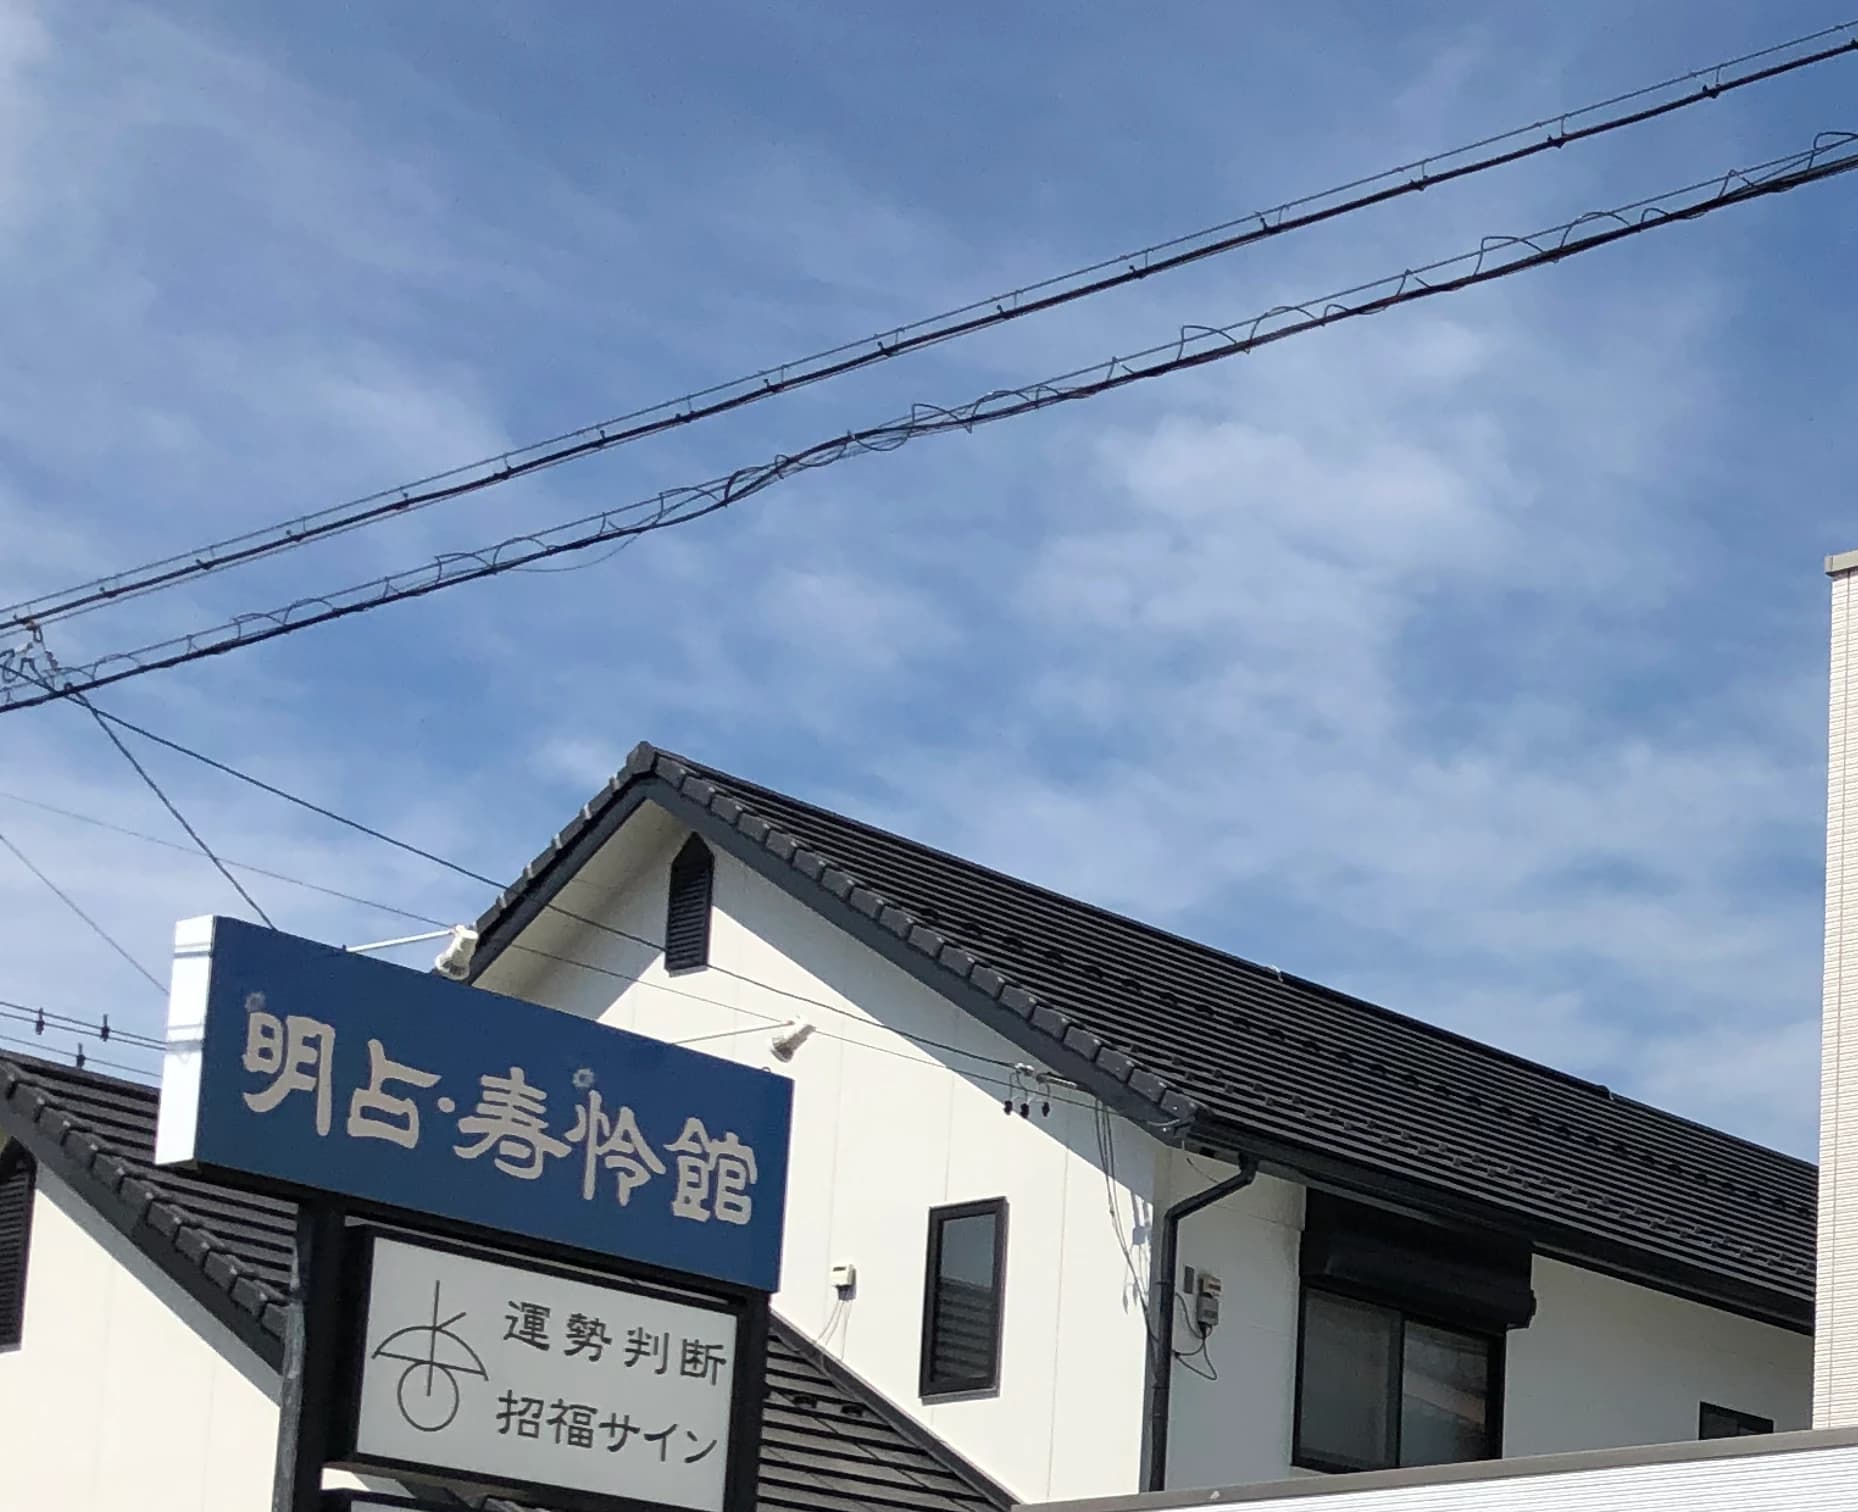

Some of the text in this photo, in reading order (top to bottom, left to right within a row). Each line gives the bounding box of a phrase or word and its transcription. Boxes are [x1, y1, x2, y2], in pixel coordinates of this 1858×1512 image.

[502, 1299, 728, 1386] 運勢判断
[496, 1389, 718, 1464] 招福サイン
